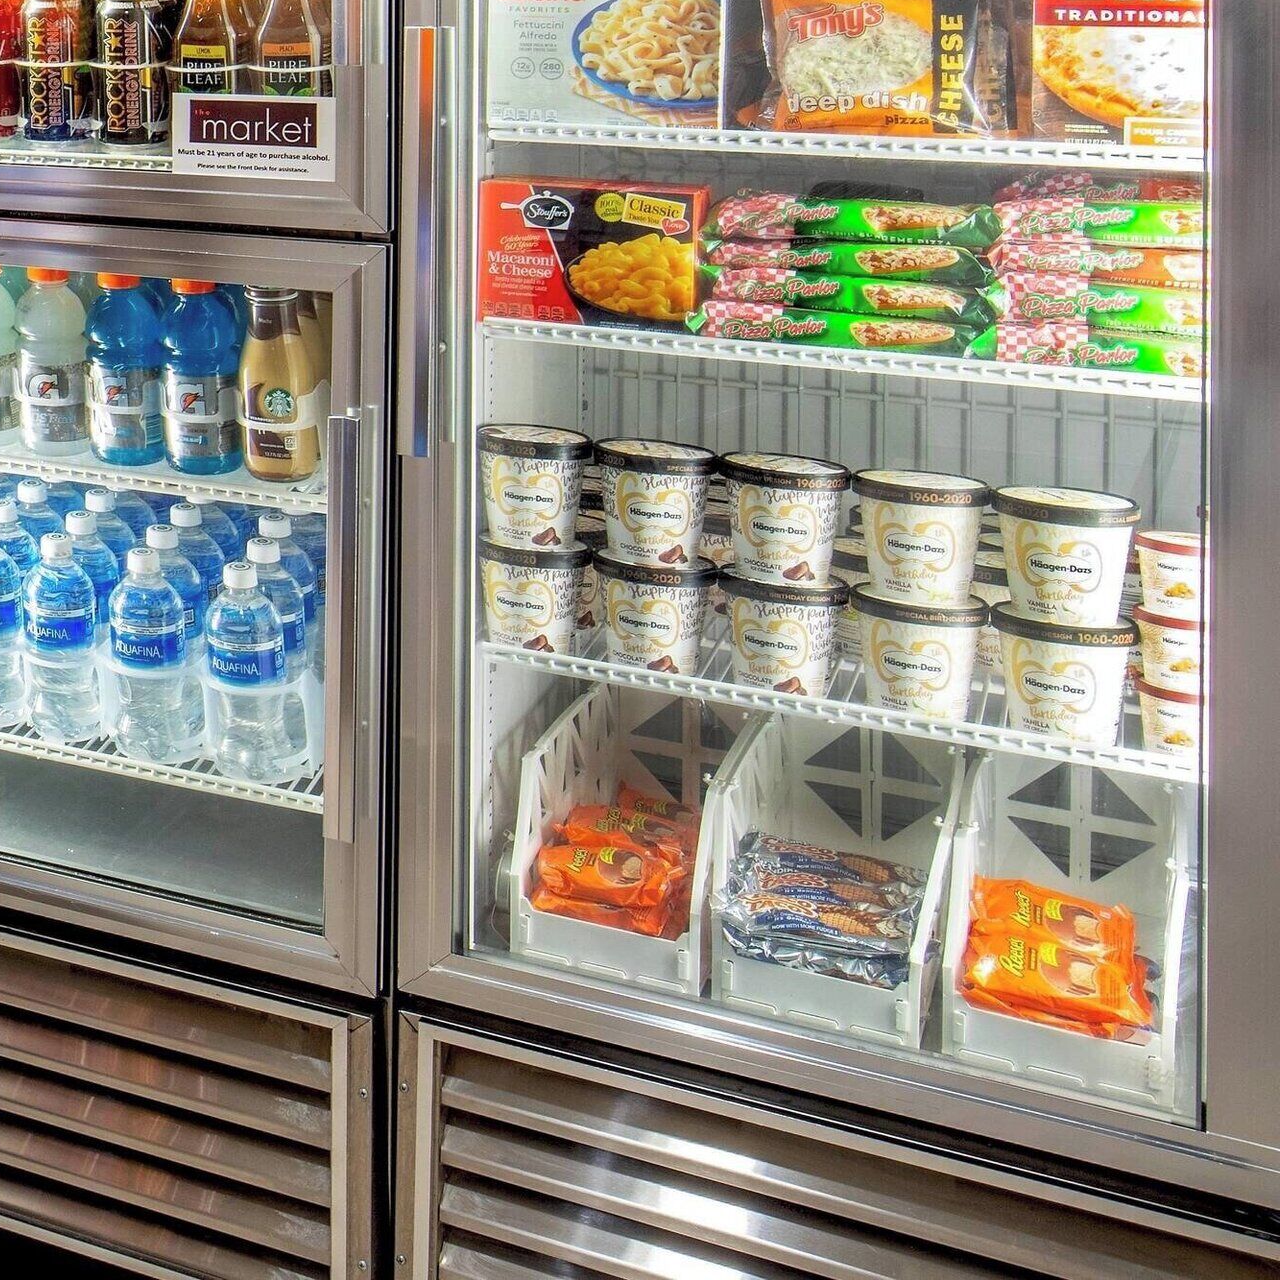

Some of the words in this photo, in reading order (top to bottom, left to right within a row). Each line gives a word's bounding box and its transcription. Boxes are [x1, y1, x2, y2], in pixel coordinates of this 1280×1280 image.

[514, 20, 564, 29] Fettuccini
[788, 2, 884, 43] Tony's
[125, 21, 138, 66] DRINK
[520, 32, 557, 40] Alfredo
[939, 15, 964, 125] CHEESE
[126, 70, 139, 128] ENERGY
[788, 93, 855, 114] deep
[862, 91, 929, 111] dish
[202, 108, 312, 143] market
[885, 114, 929, 125] pizza
[269, 153, 300, 161] purchase
[527, 204, 567, 220] Stouffer's
[629, 198, 680, 218] Classic
[488, 251, 555, 266] Macaroni
[489, 265, 499, 274] &
[502, 264, 552, 278] Cheese
[725, 323, 769, 338] Pizza
[774, 318, 826, 337] Parlor
[909, 492, 972, 504] 1960-2020
[888, 538, 945, 554] Häagen-Dazs
[744, 558, 782, 571] CHOCOLATE
[1030, 558, 1092, 575] Häagen-Dazs
[1027, 599, 1057, 610] VANILLA
[213, 656, 260, 675] AQUAFINA
